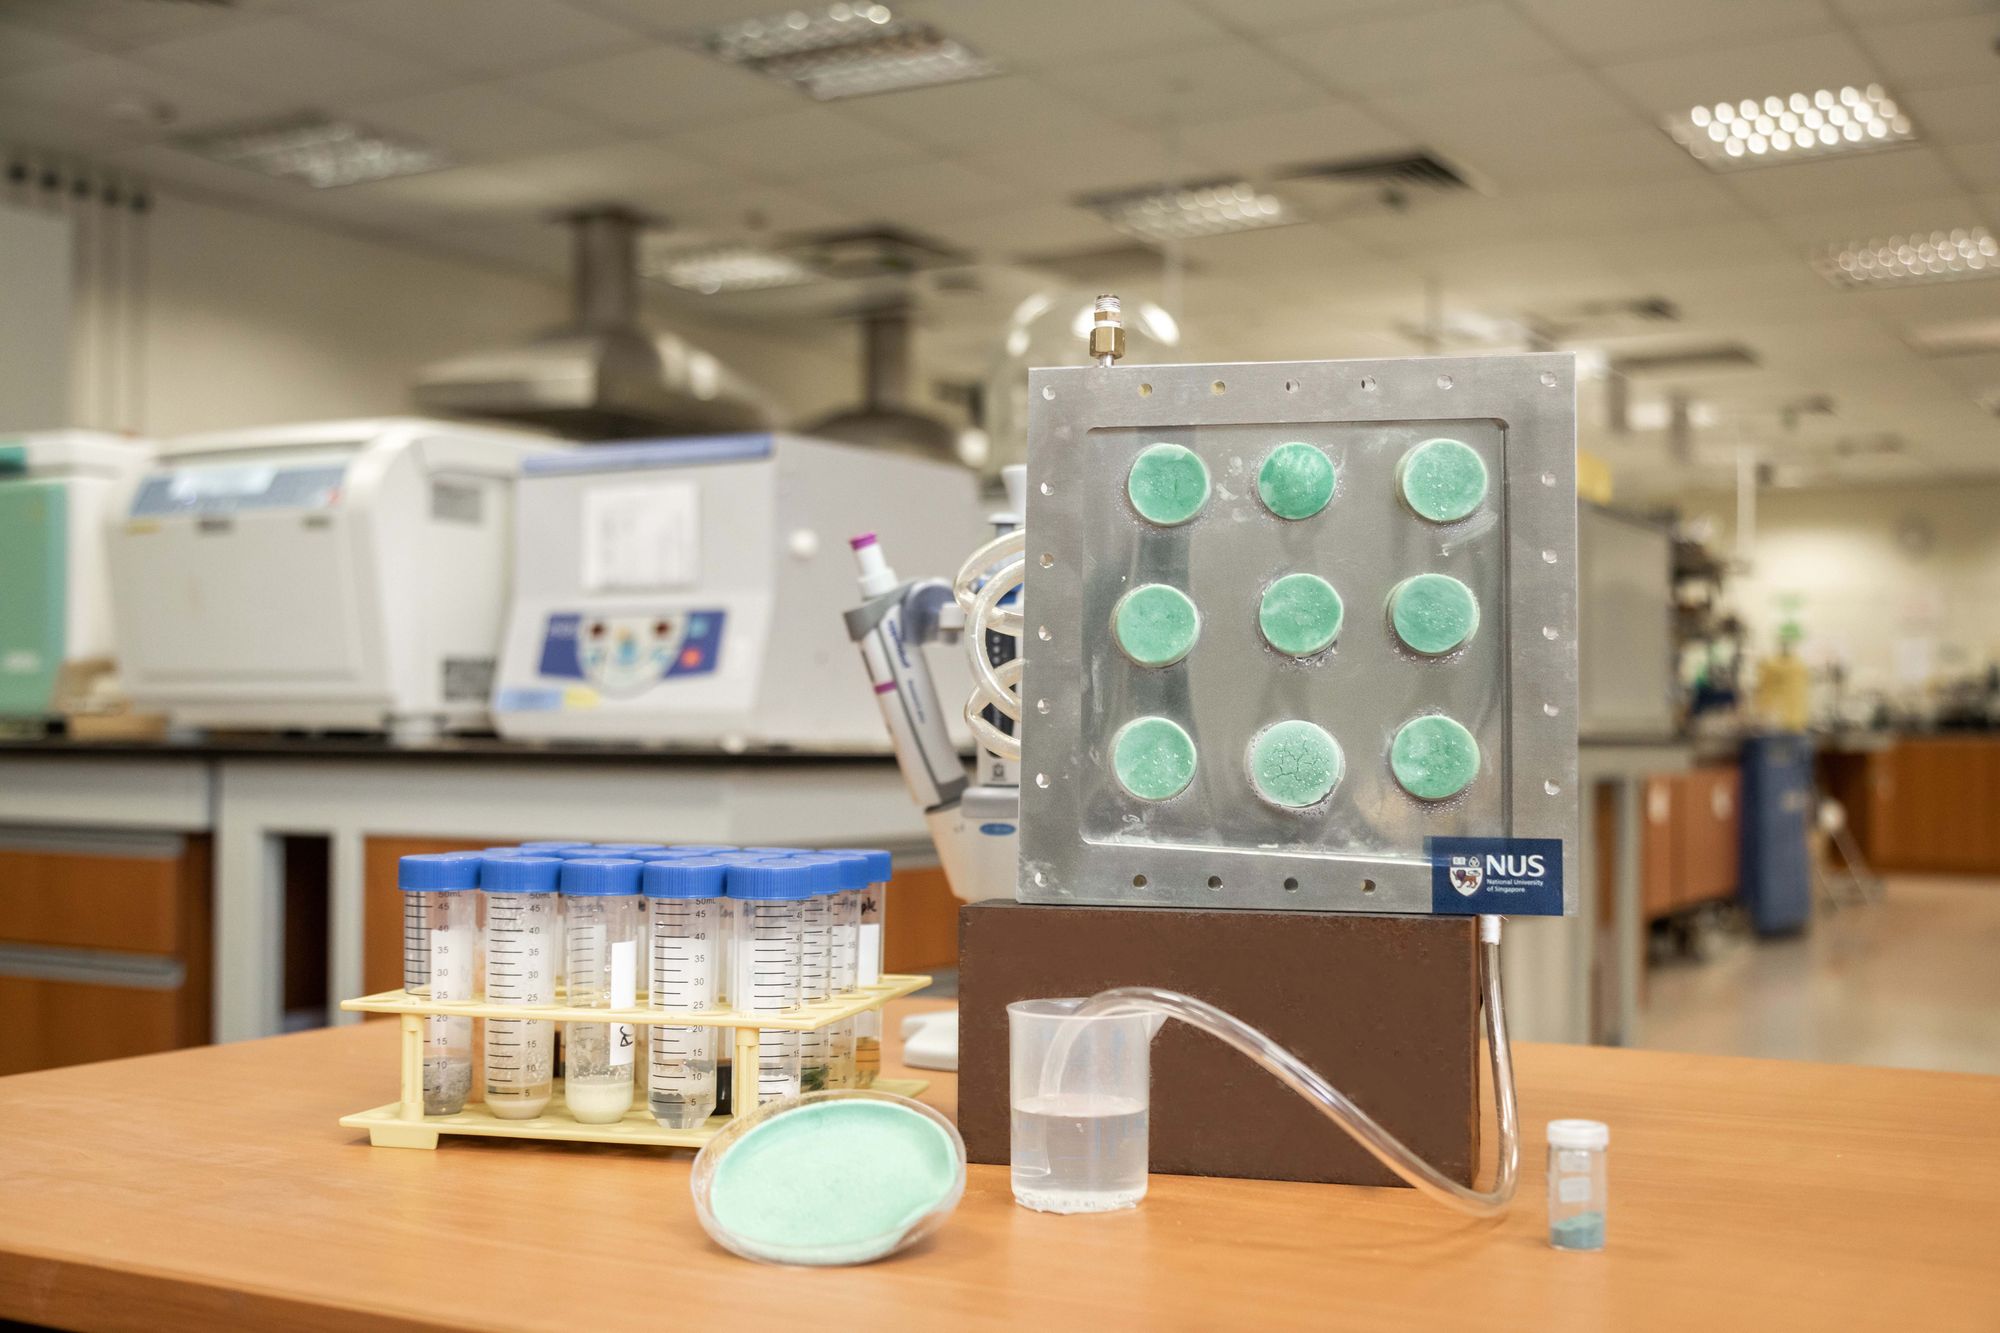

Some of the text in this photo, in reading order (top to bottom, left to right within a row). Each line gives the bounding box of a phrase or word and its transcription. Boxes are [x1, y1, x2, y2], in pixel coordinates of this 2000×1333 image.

[1486, 854, 1545, 877] NUS
[1486, 878, 1544, 887] National University
[437, 902, 450, 911] 45
[695, 898, 716, 906] 50mL
[529, 904, 541, 913] 45
[695, 909, 706, 918] 45
[528, 926, 540, 935] 40
[694, 932, 706, 941] 40
[437, 946, 449, 954] 35
[528, 948, 540, 956] 35
[694, 954, 705, 963] 35
[436, 968, 449, 977] 30
[527, 970, 539, 979] 30
[693, 977, 705, 986] 30
[436, 991, 449, 1000] 25
[527, 993, 538, 1002] 25
[693, 1001, 704, 1009] 25
[436, 1014, 448, 1022] 20
[526, 1017, 537, 1025] 20
[692, 1024, 703, 1033] 20
[436, 1037, 448, 1046] 15
[526, 1040, 537, 1048] 15
[692, 1048, 703, 1057] 15
[436, 1061, 448, 1069] 10
[526, 1064, 537, 1072] 10
[692, 1072, 702, 1081] 10
[524, 1089, 530, 1097] 5
[690, 1098, 697, 1106] 5
